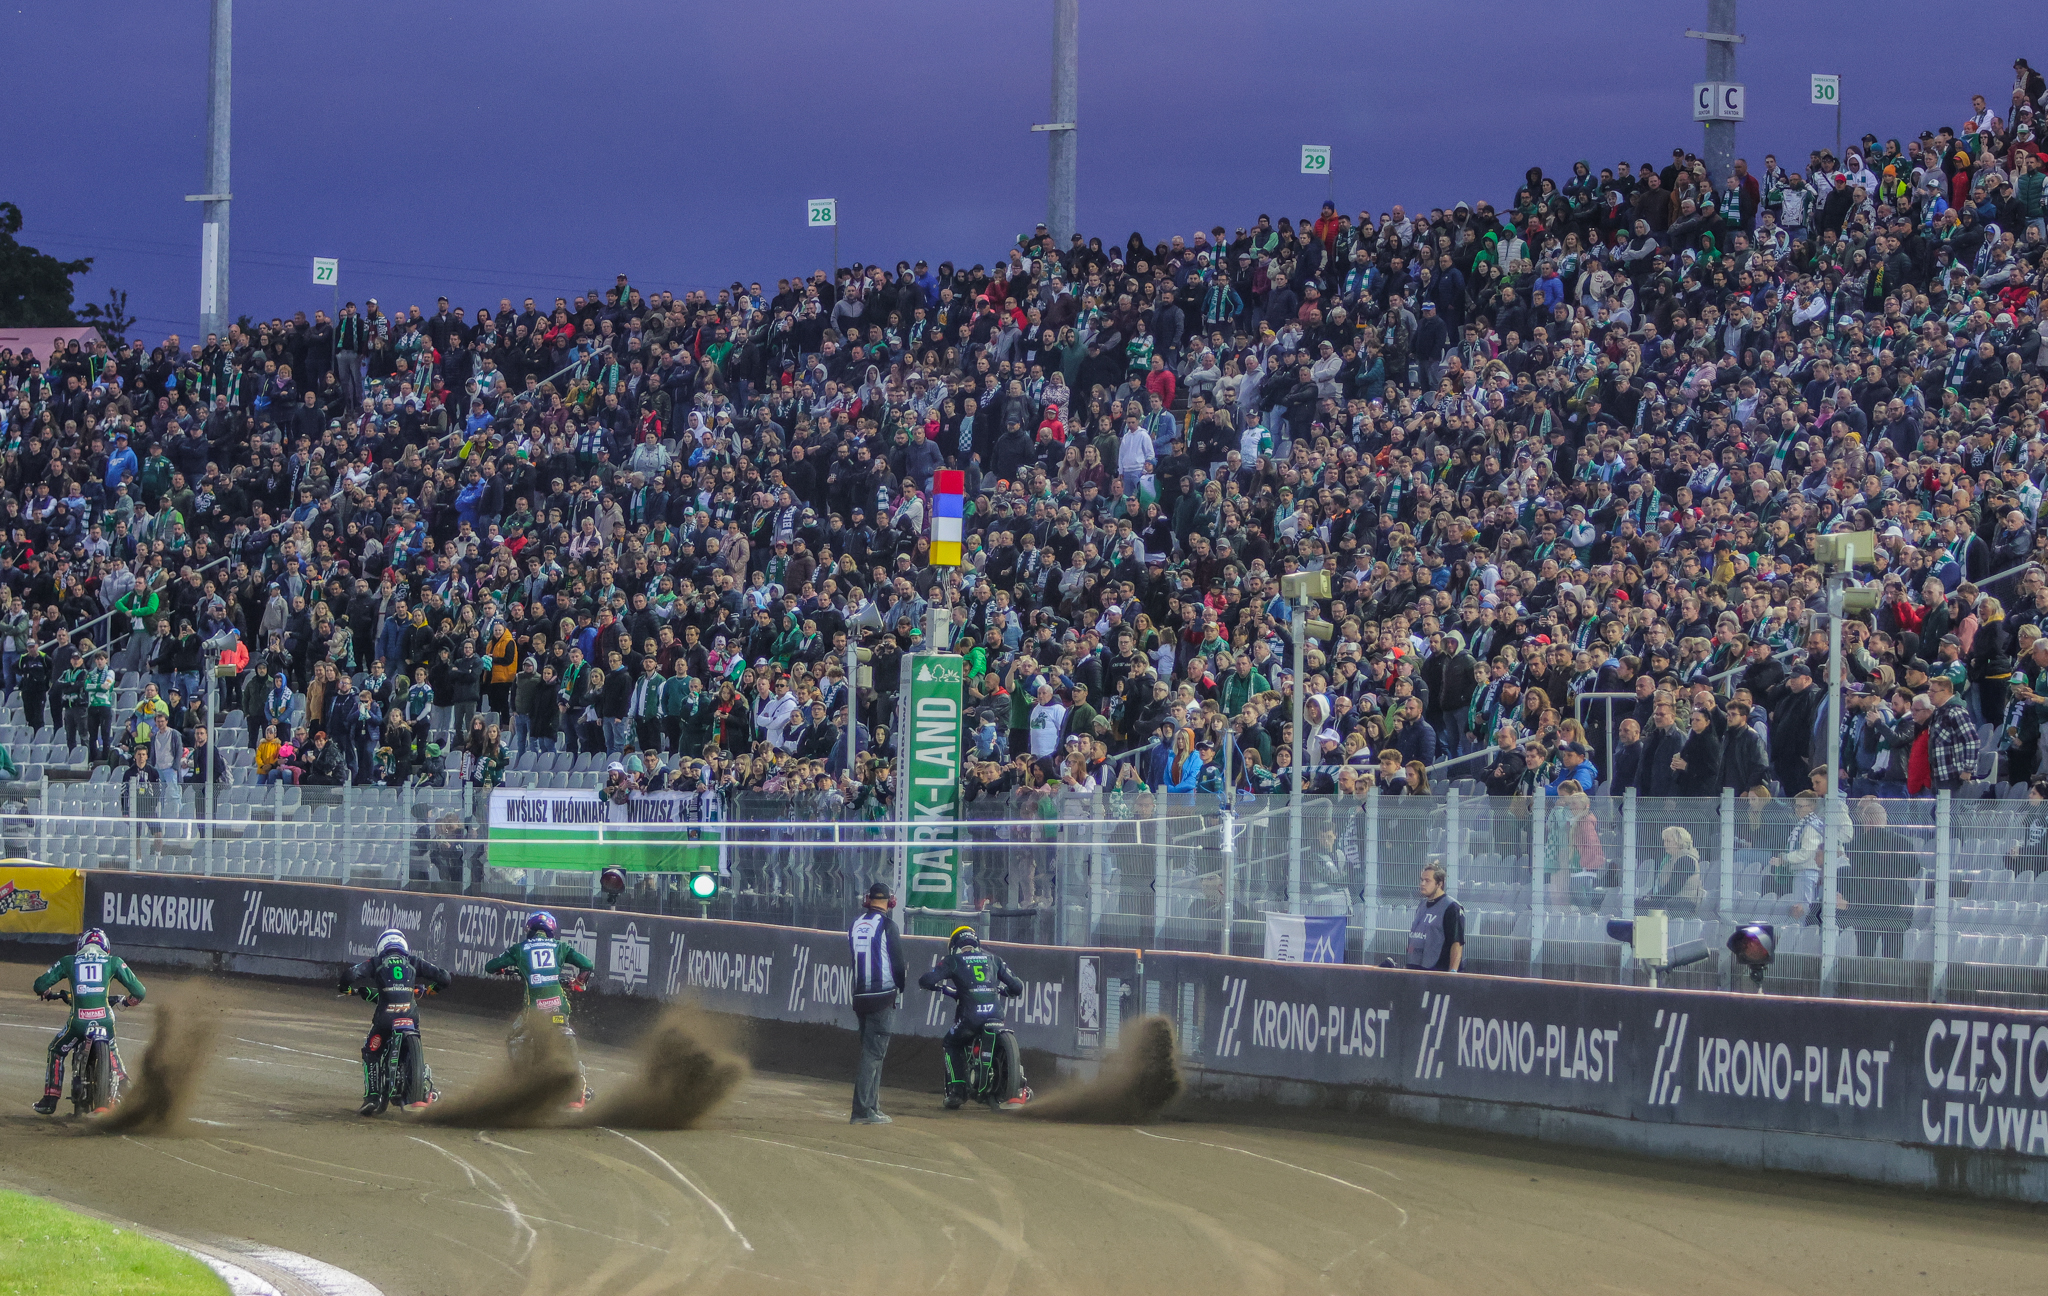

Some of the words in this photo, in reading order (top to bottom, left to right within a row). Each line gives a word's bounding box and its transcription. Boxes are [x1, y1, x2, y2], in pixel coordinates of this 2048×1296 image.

[1700, 87, 1710, 109] C
[1725, 87, 1738, 110] C
[1814, 84, 1835, 100] 30
[1305, 155, 1325, 169] 29
[812, 208, 831, 221] 28
[316, 266, 333, 280] 27
[911, 697, 957, 893] DARK-LAND
[506, 795, 548, 823] MYŚLISZ
[552, 796, 610, 823] WŁÓKNIARZ
[627, 799, 673, 823] WIDZISZ
[103, 890, 215, 933] BLASKBRUK
[260, 904, 332, 939] KRONO-PLAST
[361, 898, 391, 930] Obiady
[391, 902, 422, 931] Domowe
[1423, 913, 1437, 923] TV
[534, 950, 552, 967] 12
[618, 945, 642, 973] REALL
[85, 965, 97, 980] 11
[393, 966, 404, 980] 6
[688, 949, 773, 996] KRONO-PLAST
[973, 965, 986, 982] 5
[976, 1004, 994, 1013] 117
[1252, 998, 1390, 1060] KRONO-PLAST
[1457, 1015, 1619, 1084] KRONO-PLAST
[1698, 1036, 1890, 1109] KRONO-PLAST
